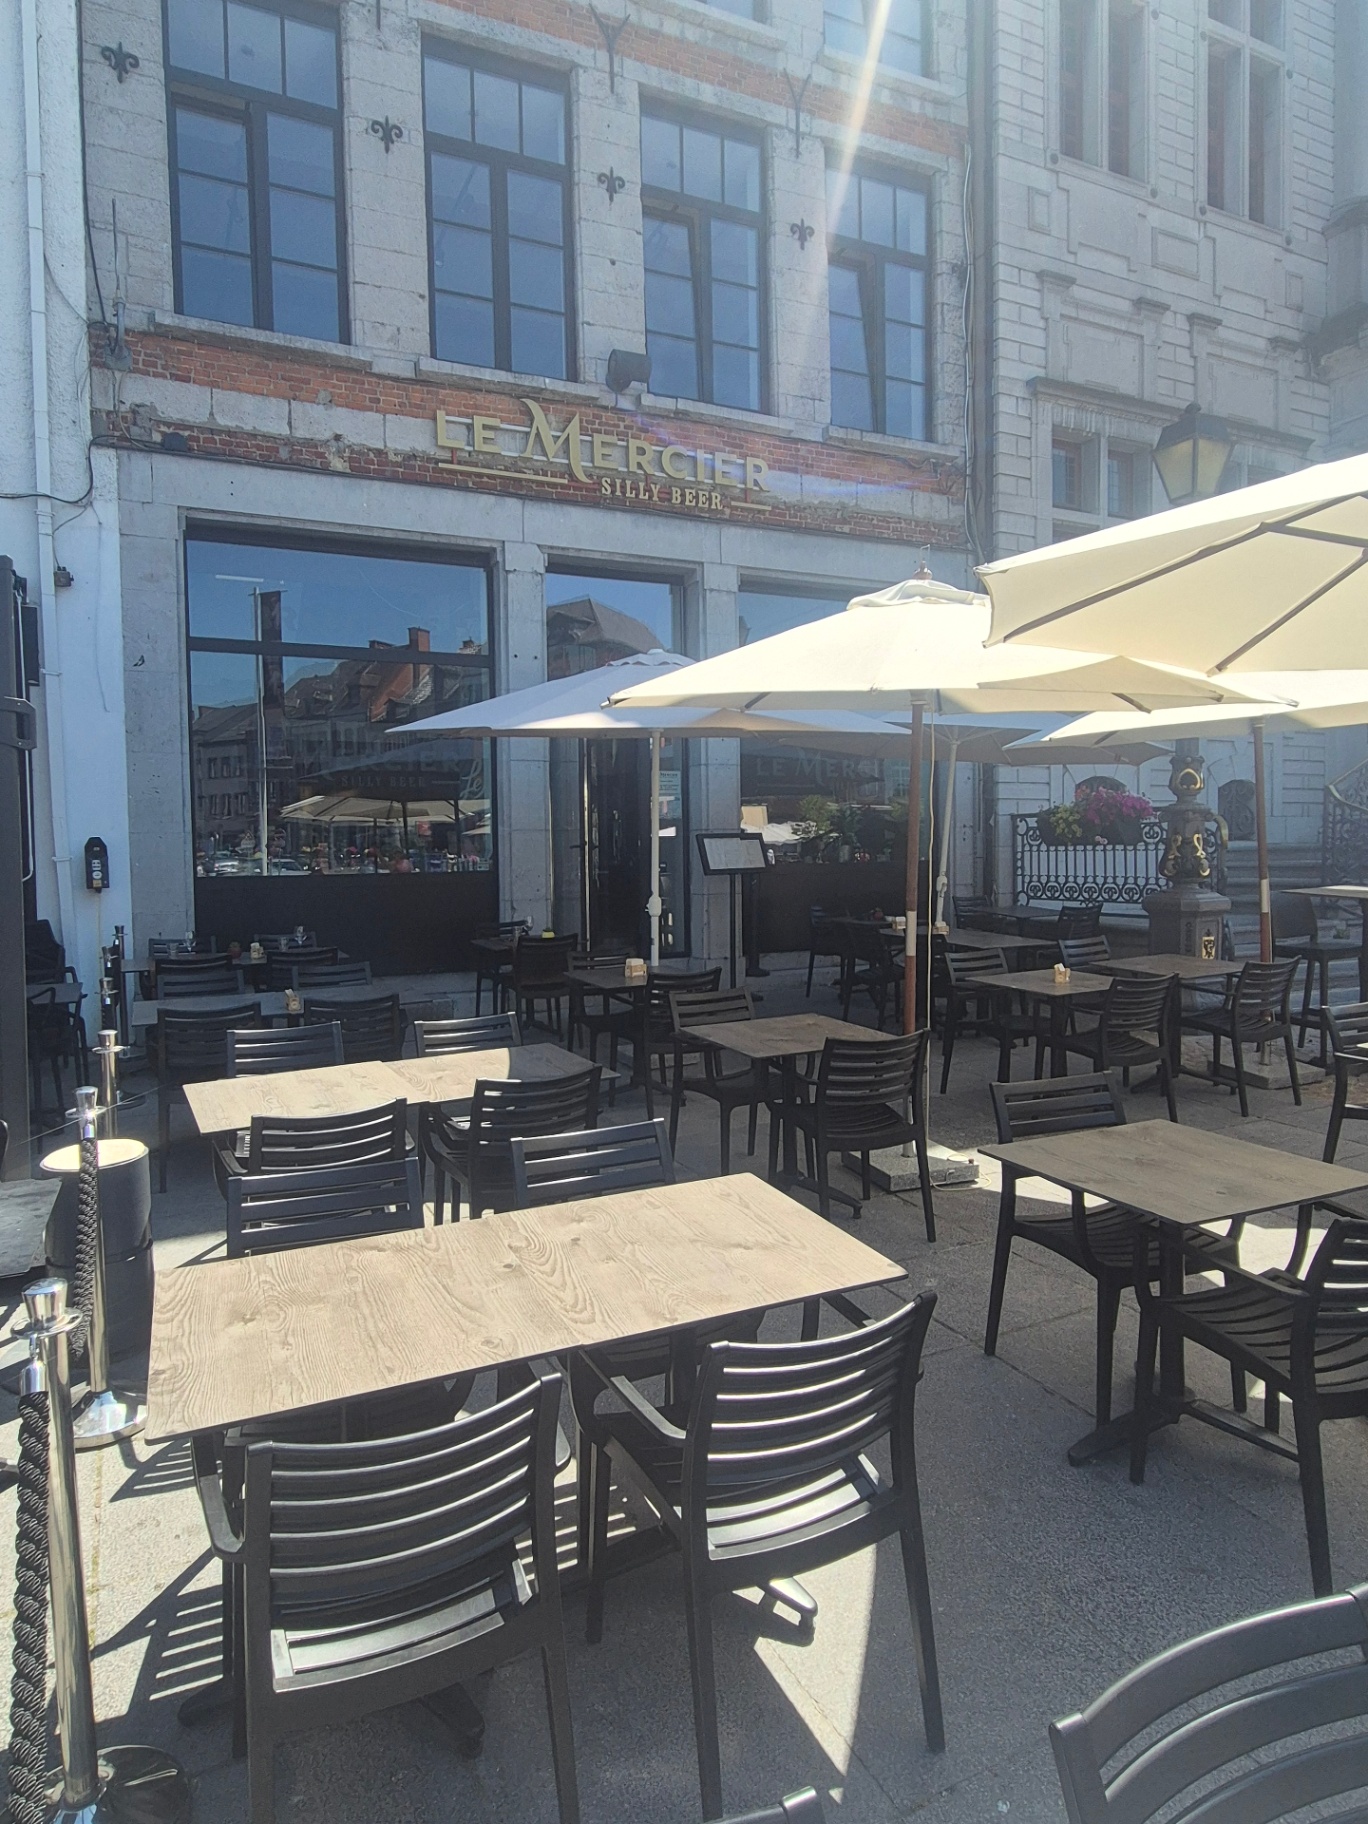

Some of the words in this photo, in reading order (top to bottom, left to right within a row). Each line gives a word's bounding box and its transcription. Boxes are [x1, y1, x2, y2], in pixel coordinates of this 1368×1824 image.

[436, 409, 502, 451] LE
[519, 398, 770, 492] MERCIER
[601, 476, 661, 502] SILLY
[671, 487, 724, 510] BEER
